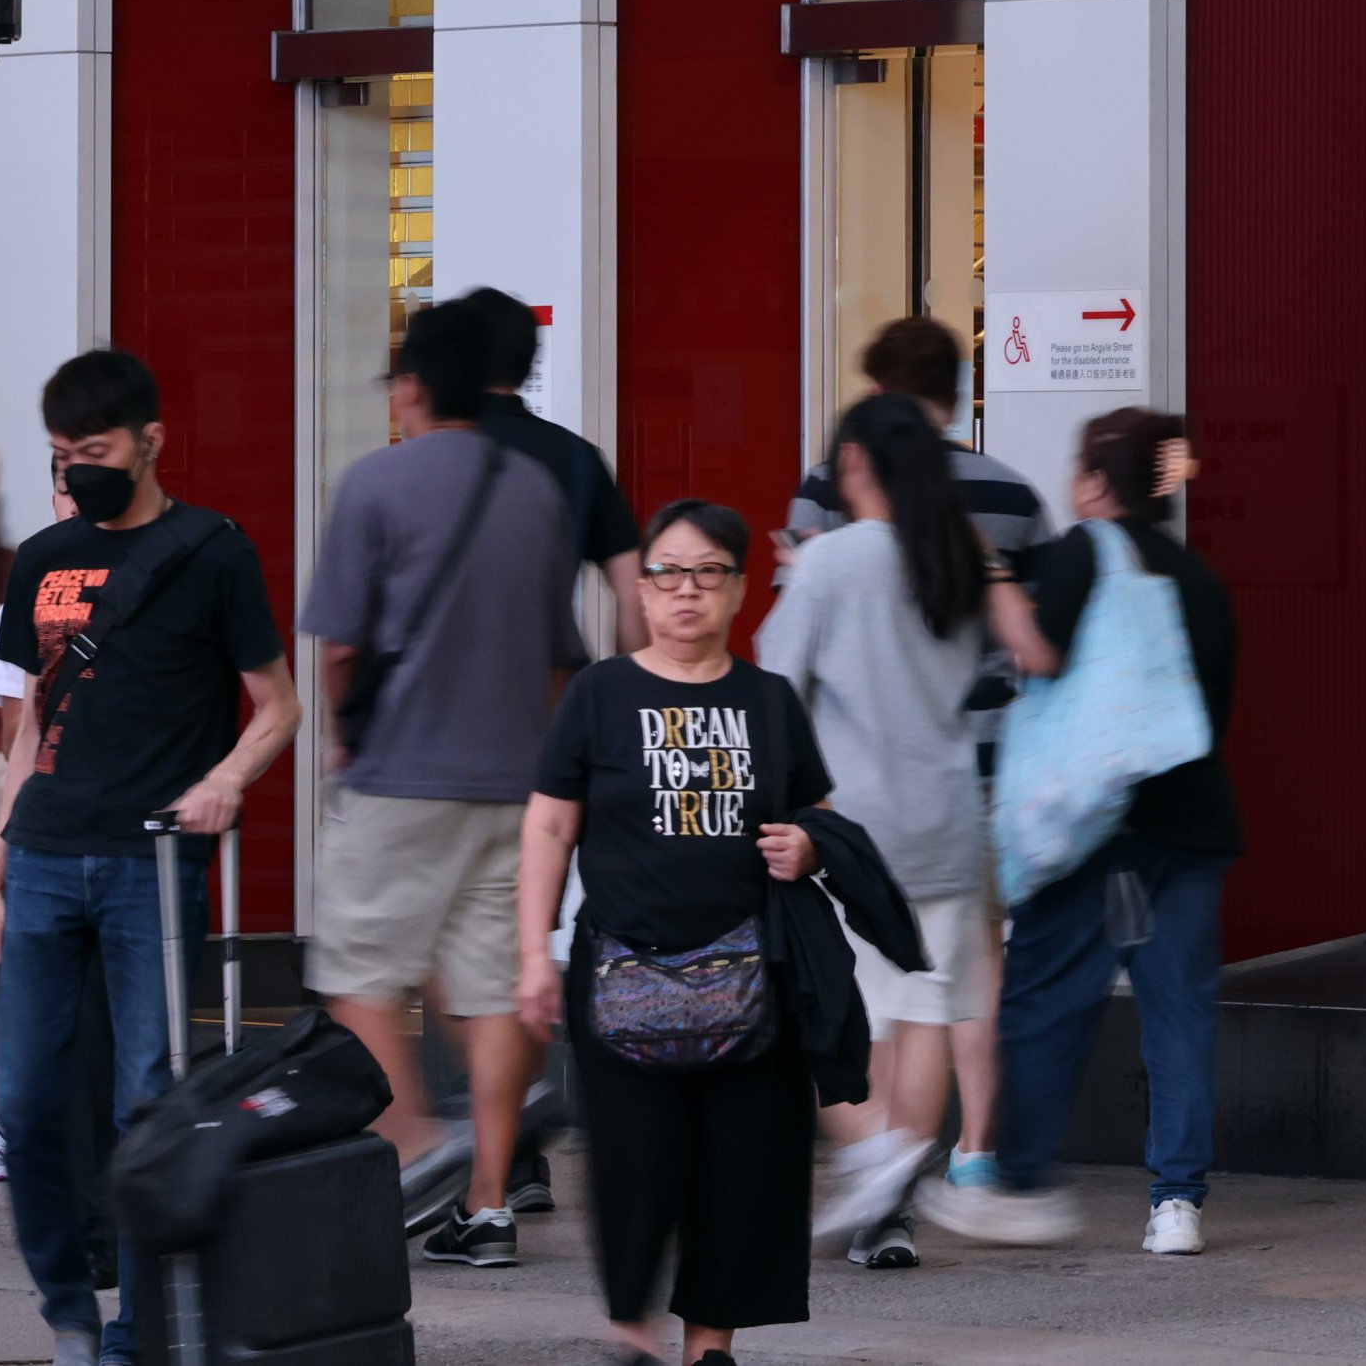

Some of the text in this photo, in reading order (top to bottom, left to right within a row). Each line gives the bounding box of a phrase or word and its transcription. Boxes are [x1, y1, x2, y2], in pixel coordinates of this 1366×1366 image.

[1050, 342, 1133, 354] Please go to Argyle Street
[1050, 356, 1130, 365] for the disabled entrance
[39, 569, 85, 588] PEACE
[36, 587, 82, 606] GET US
[35, 602, 93, 622] THROUGH
[638, 707, 751, 750] DREAM
[643, 748, 755, 791] TO BE
